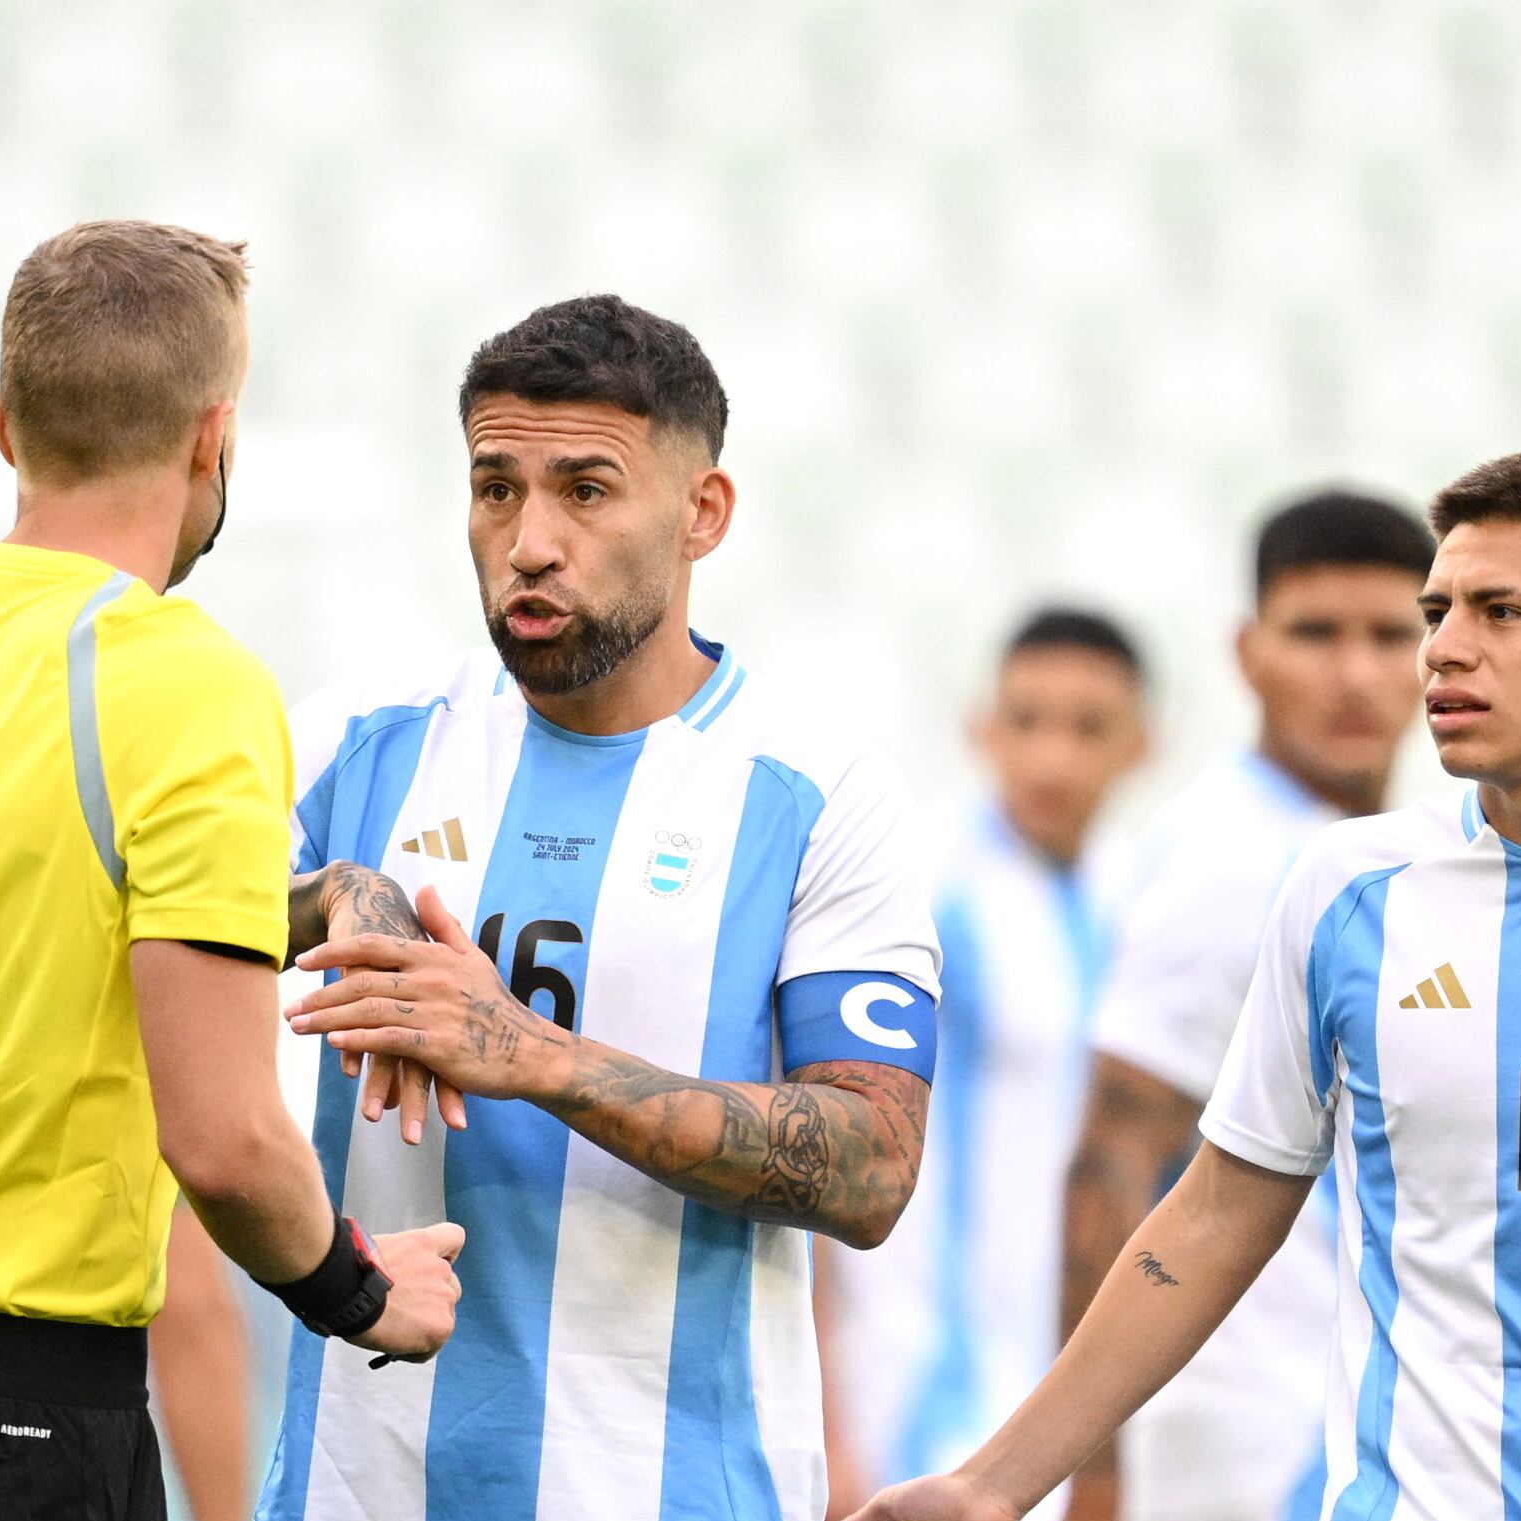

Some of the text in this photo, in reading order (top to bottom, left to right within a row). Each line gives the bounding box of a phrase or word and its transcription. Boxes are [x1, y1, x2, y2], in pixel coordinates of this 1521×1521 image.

[523, 832, 559, 844] ARGENTINA
[565, 837, 596, 846] MOROCCO
[536, 843, 579, 854] 24 JULY 2024
[532, 851, 580, 861] SAINT-ETIENNE
[840, 981, 918, 1049] C
[0, 1423, 52, 1440] AEROREADY
